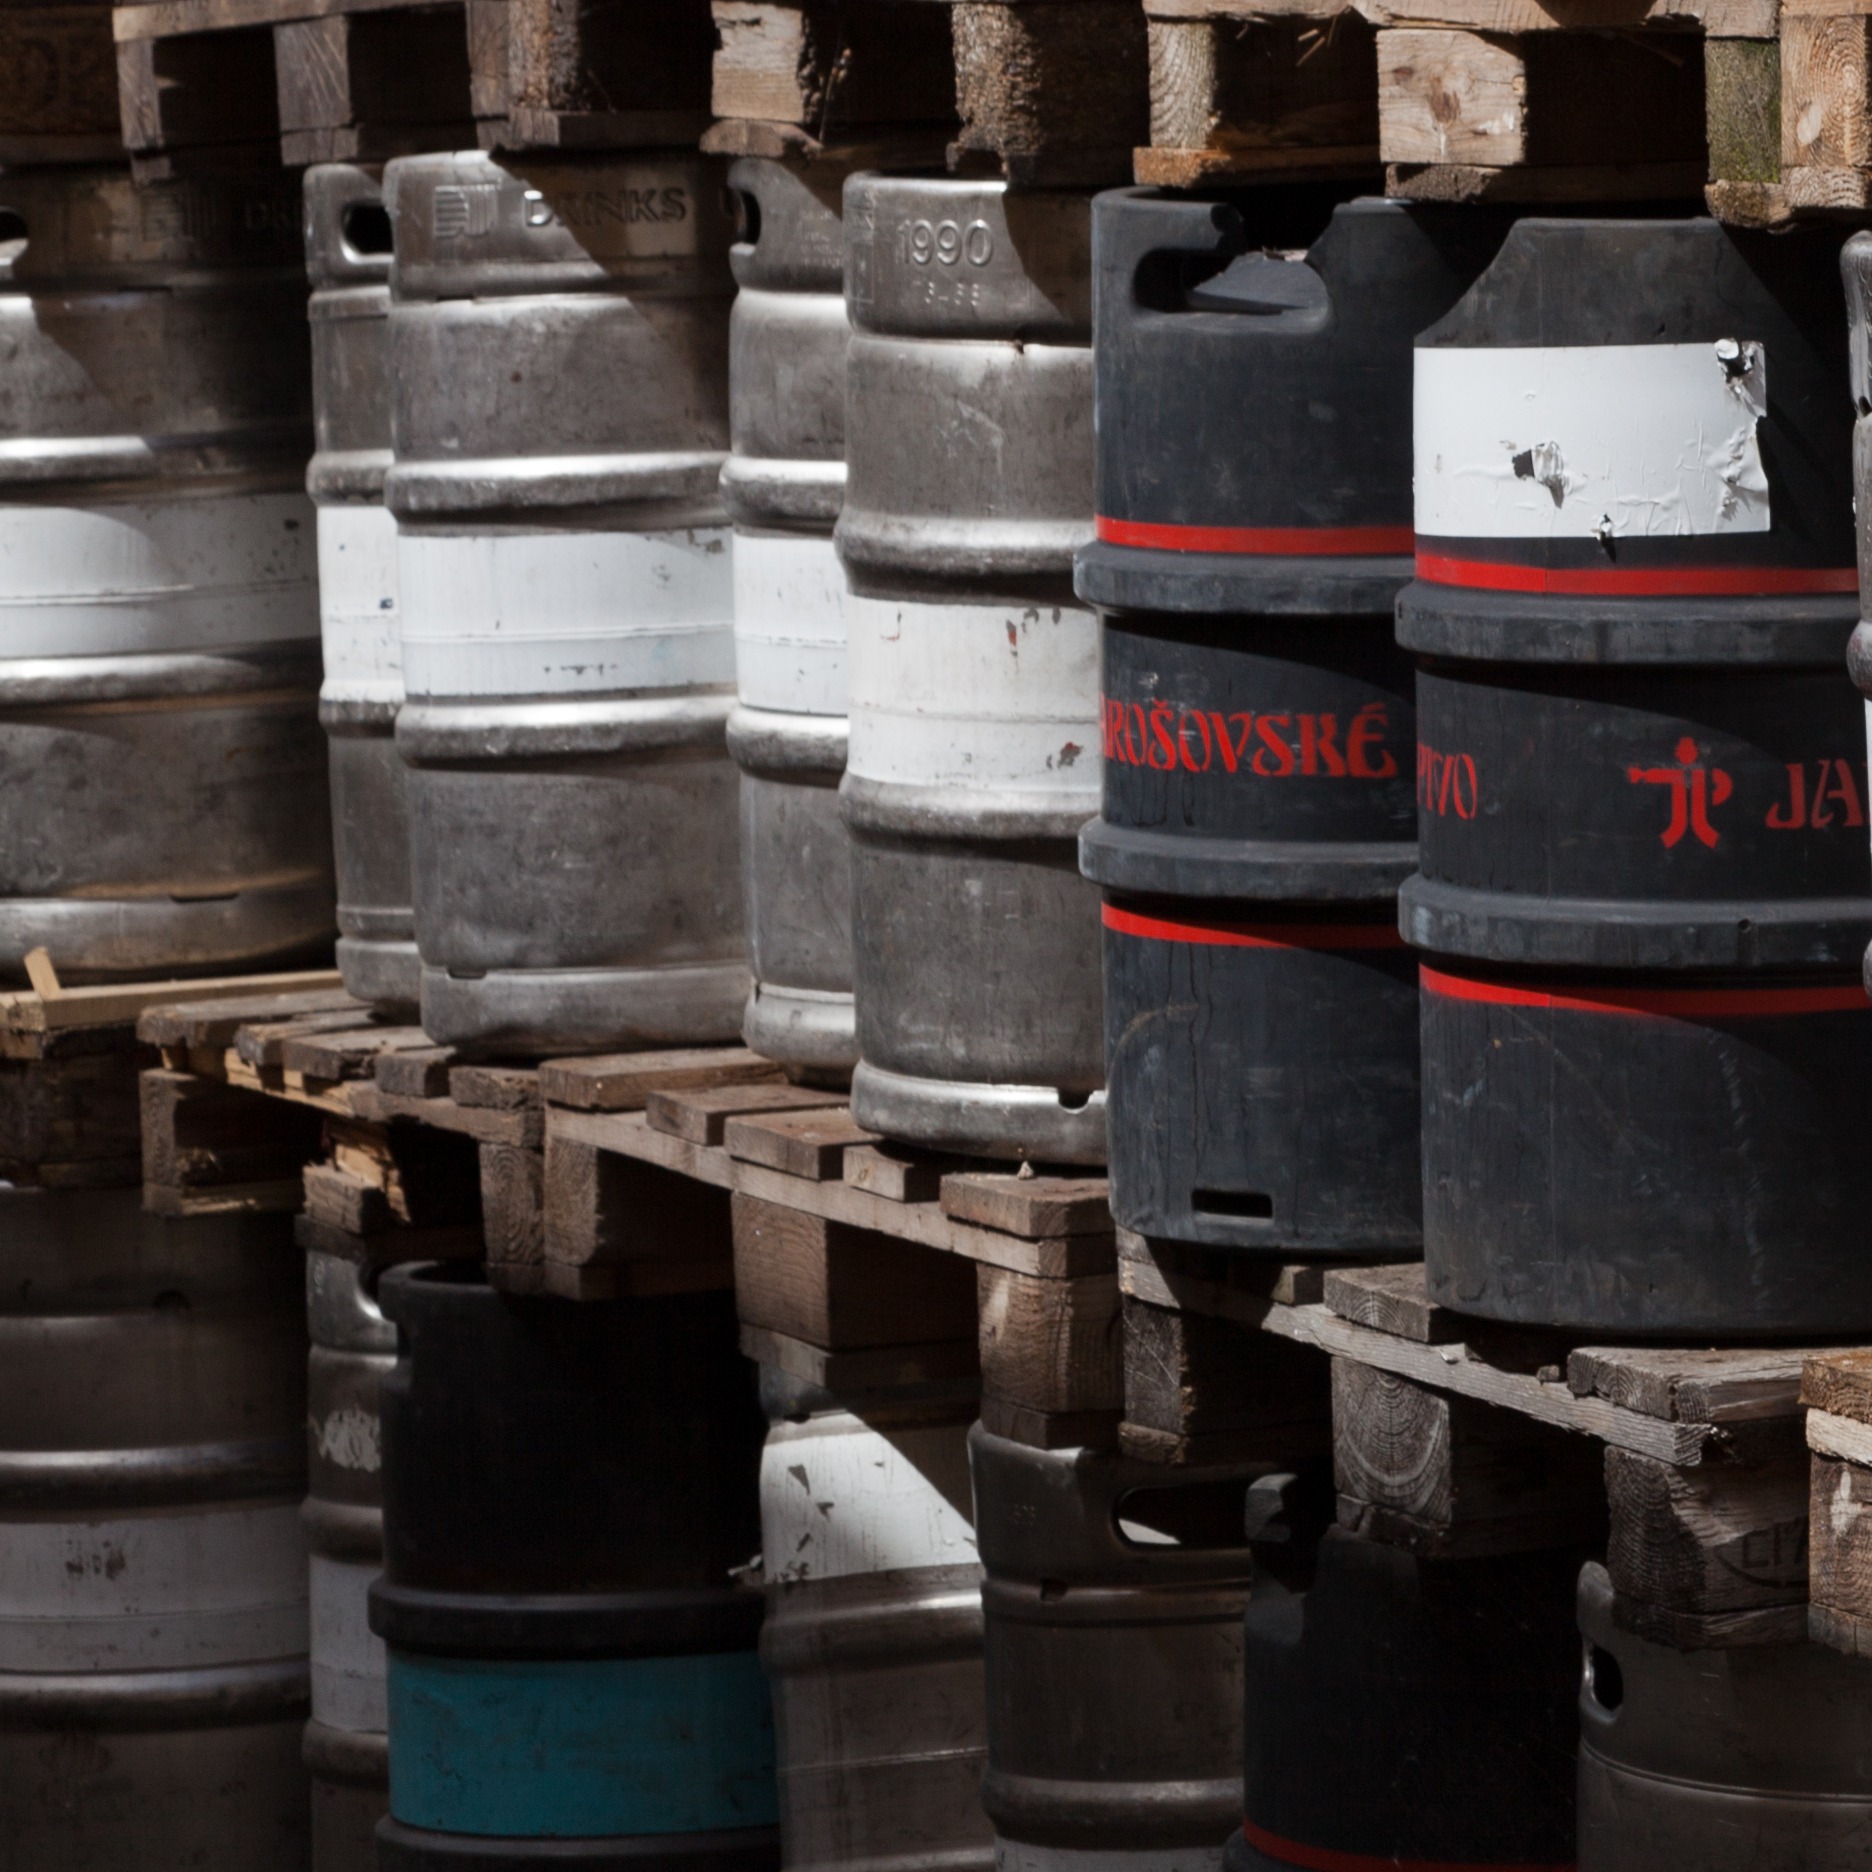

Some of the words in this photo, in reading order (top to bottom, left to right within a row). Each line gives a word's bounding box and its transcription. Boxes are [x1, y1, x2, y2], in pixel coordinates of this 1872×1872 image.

[523, 188, 687, 226] DRINKS
[897, 218, 994, 266] 1990
[1100, 692, 1398, 780] ROŠOVSKÉ
[1765, 758, 1870, 830] JA
